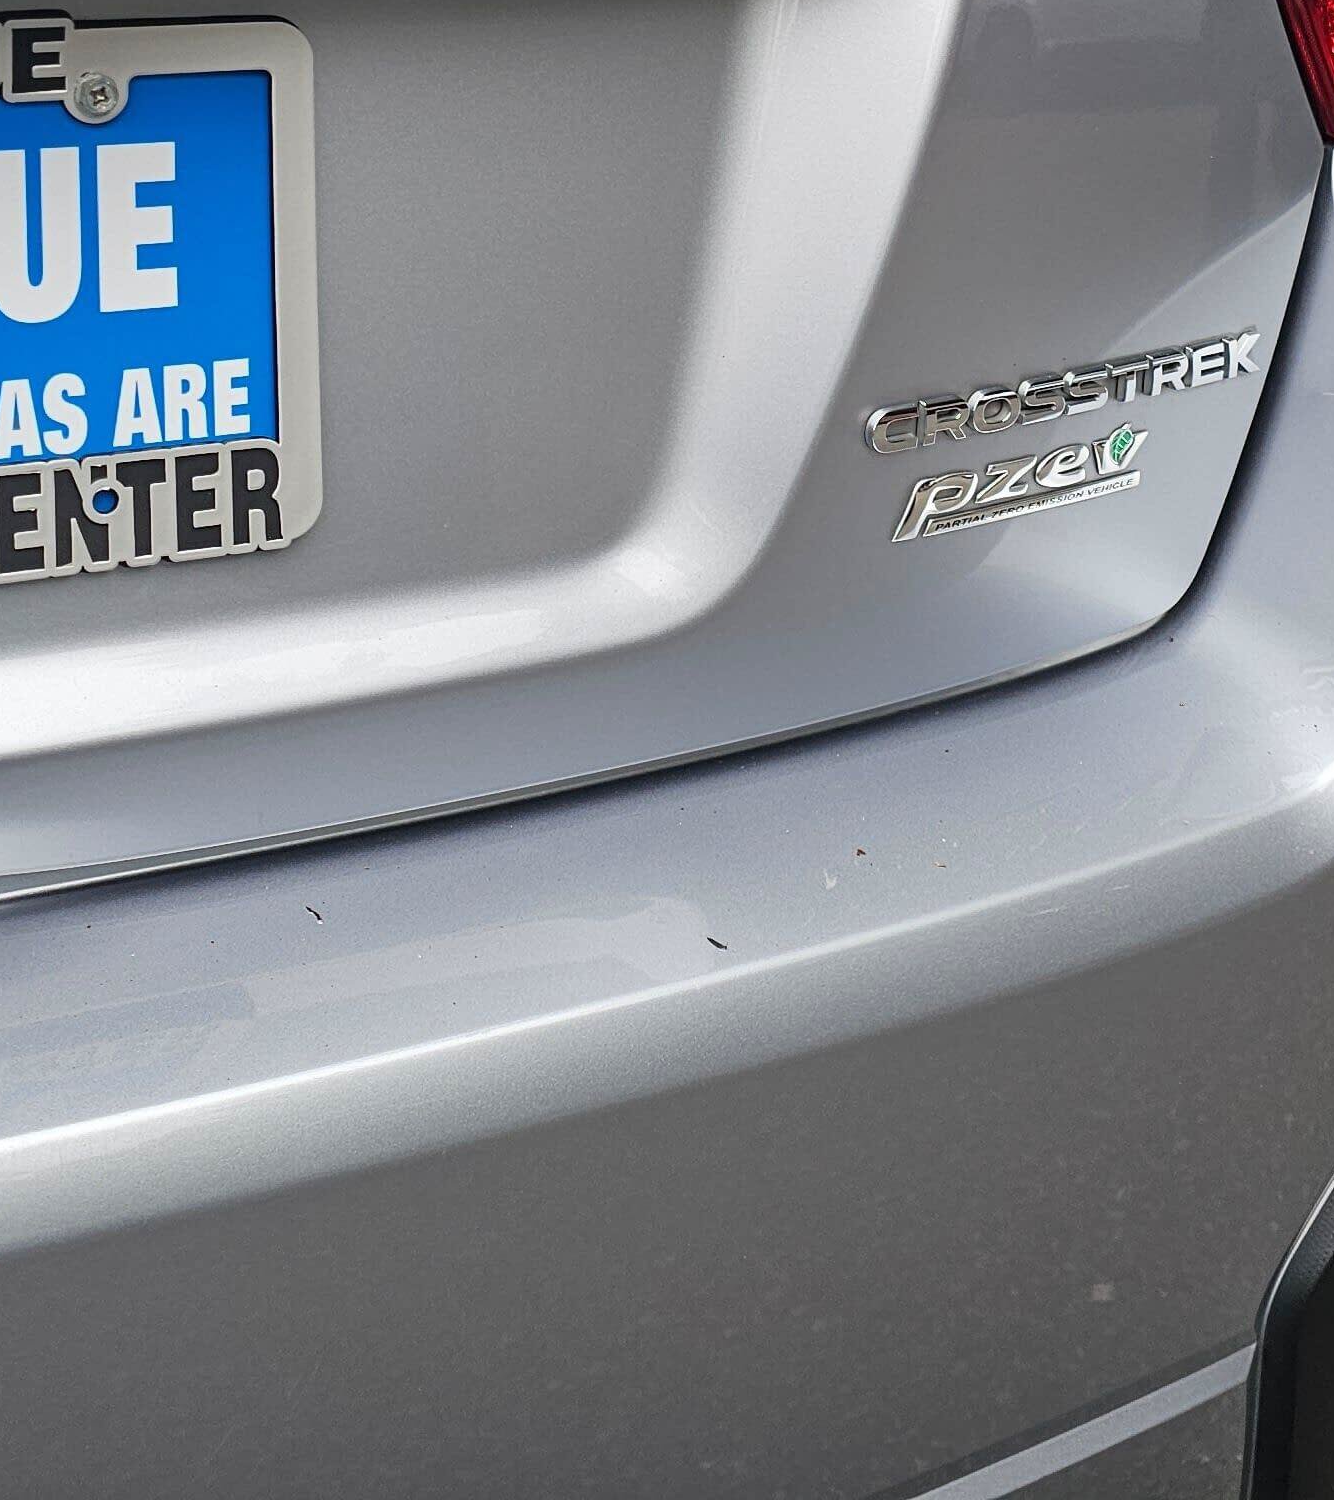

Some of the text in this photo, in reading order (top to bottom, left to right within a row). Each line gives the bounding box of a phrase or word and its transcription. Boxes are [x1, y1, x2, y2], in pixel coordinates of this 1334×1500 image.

[112, 357, 252, 447] ARE
[865, 331, 1262, 454] CROSSTREK
[934, 513, 987, 532] PARTIAL
[1026, 490, 1085, 511] EMISSION
[1086, 477, 1135, 497] VEHICLE
